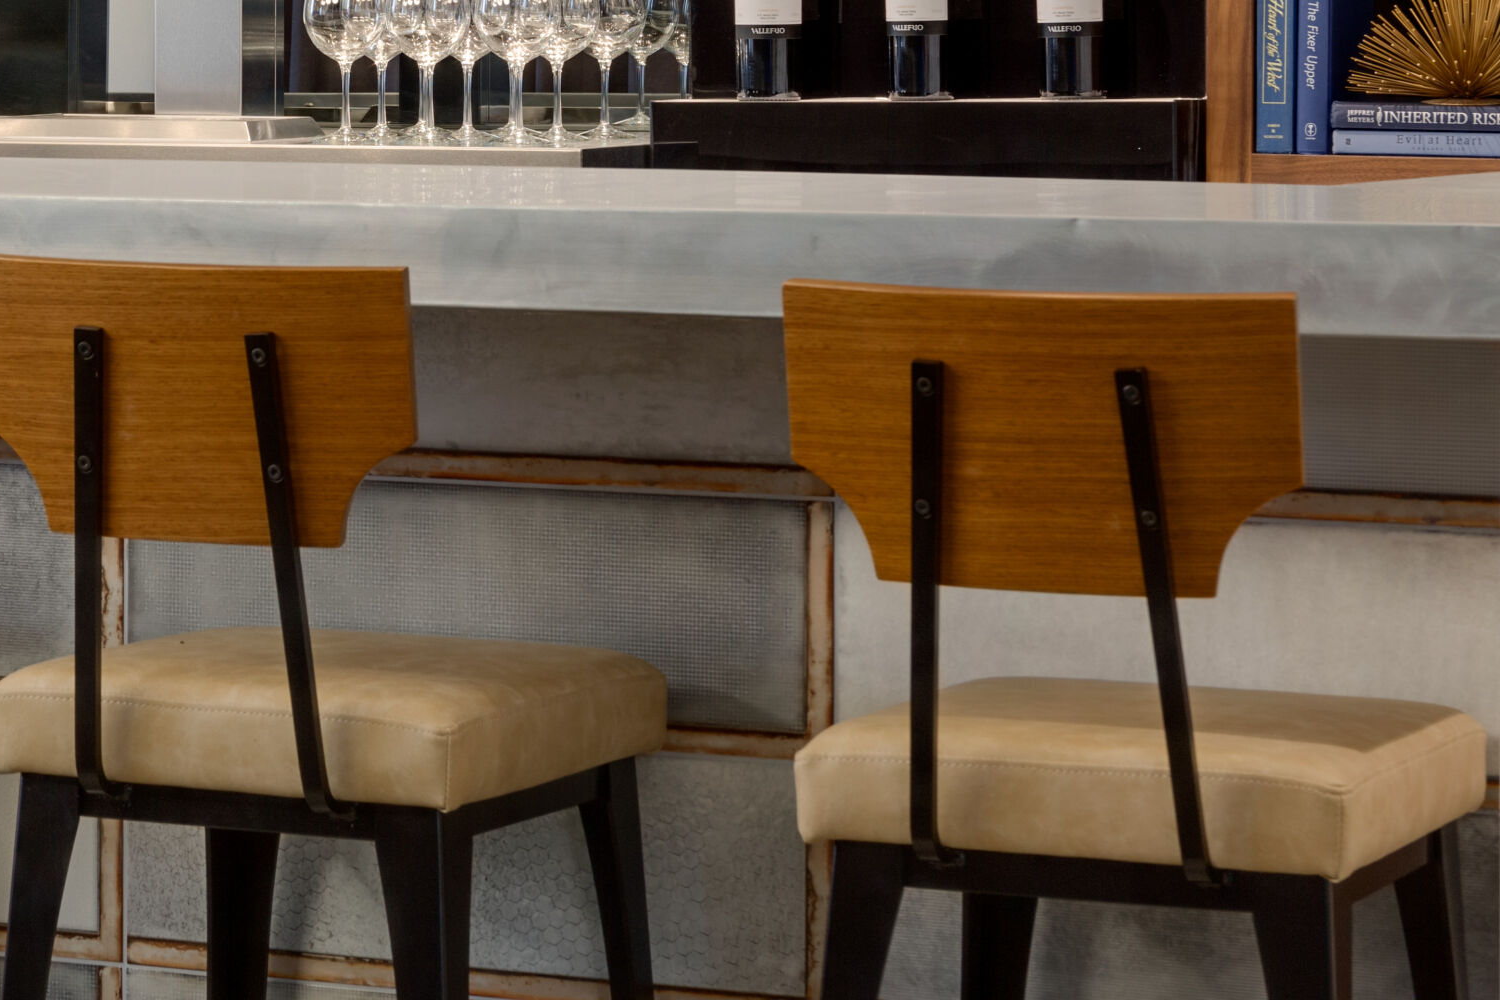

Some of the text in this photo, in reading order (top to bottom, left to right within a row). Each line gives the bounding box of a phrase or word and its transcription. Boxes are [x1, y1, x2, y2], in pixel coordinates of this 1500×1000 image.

[1304, 1, 1319, 90] The Fixer Upper
[1266, 58, 1282, 93] West
[1384, 111, 1468, 125] INHERITED
[1396, 135, 1483, 146] Evil at Heart
